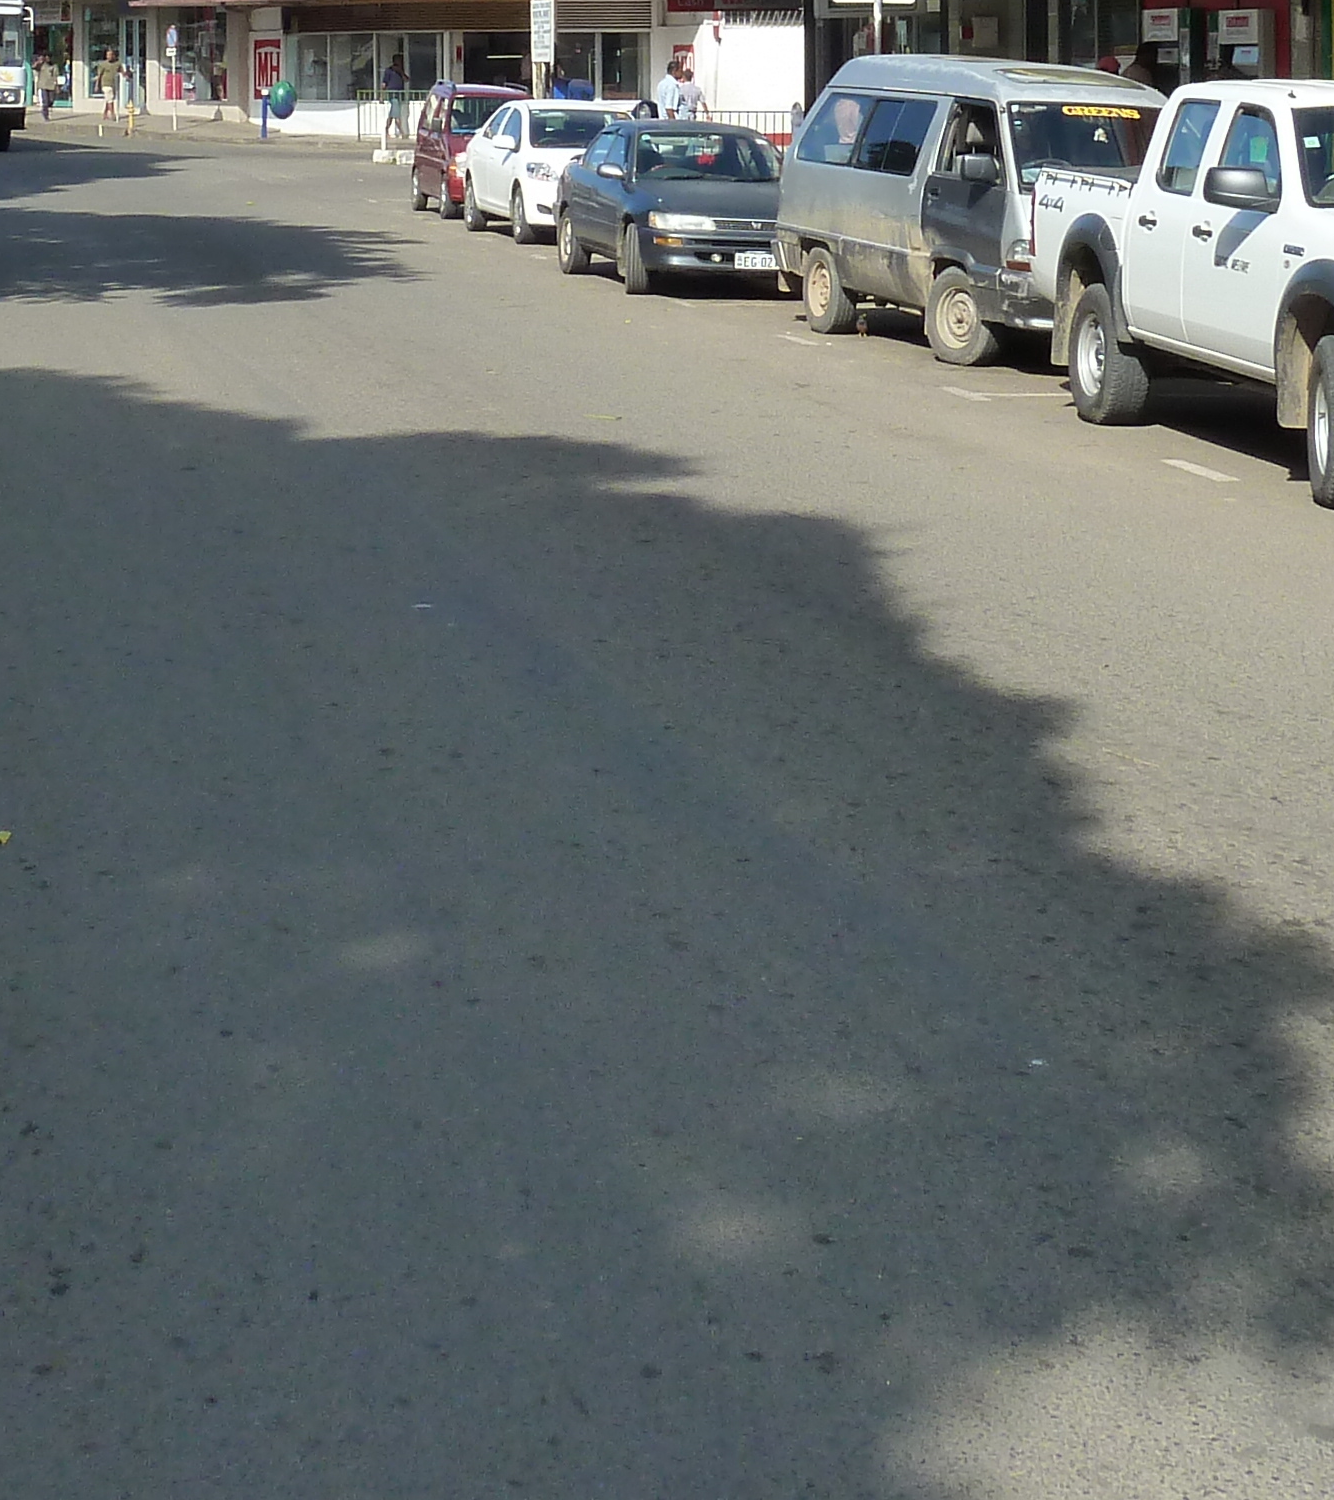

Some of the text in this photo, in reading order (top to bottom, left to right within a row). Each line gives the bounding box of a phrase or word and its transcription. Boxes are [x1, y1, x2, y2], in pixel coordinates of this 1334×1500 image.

[257, 51, 280, 88] MH
[1061, 105, 1141, 120] GREENS
[1038, 193, 1064, 212] 4x4
[743, 256, 757, 268] EG
